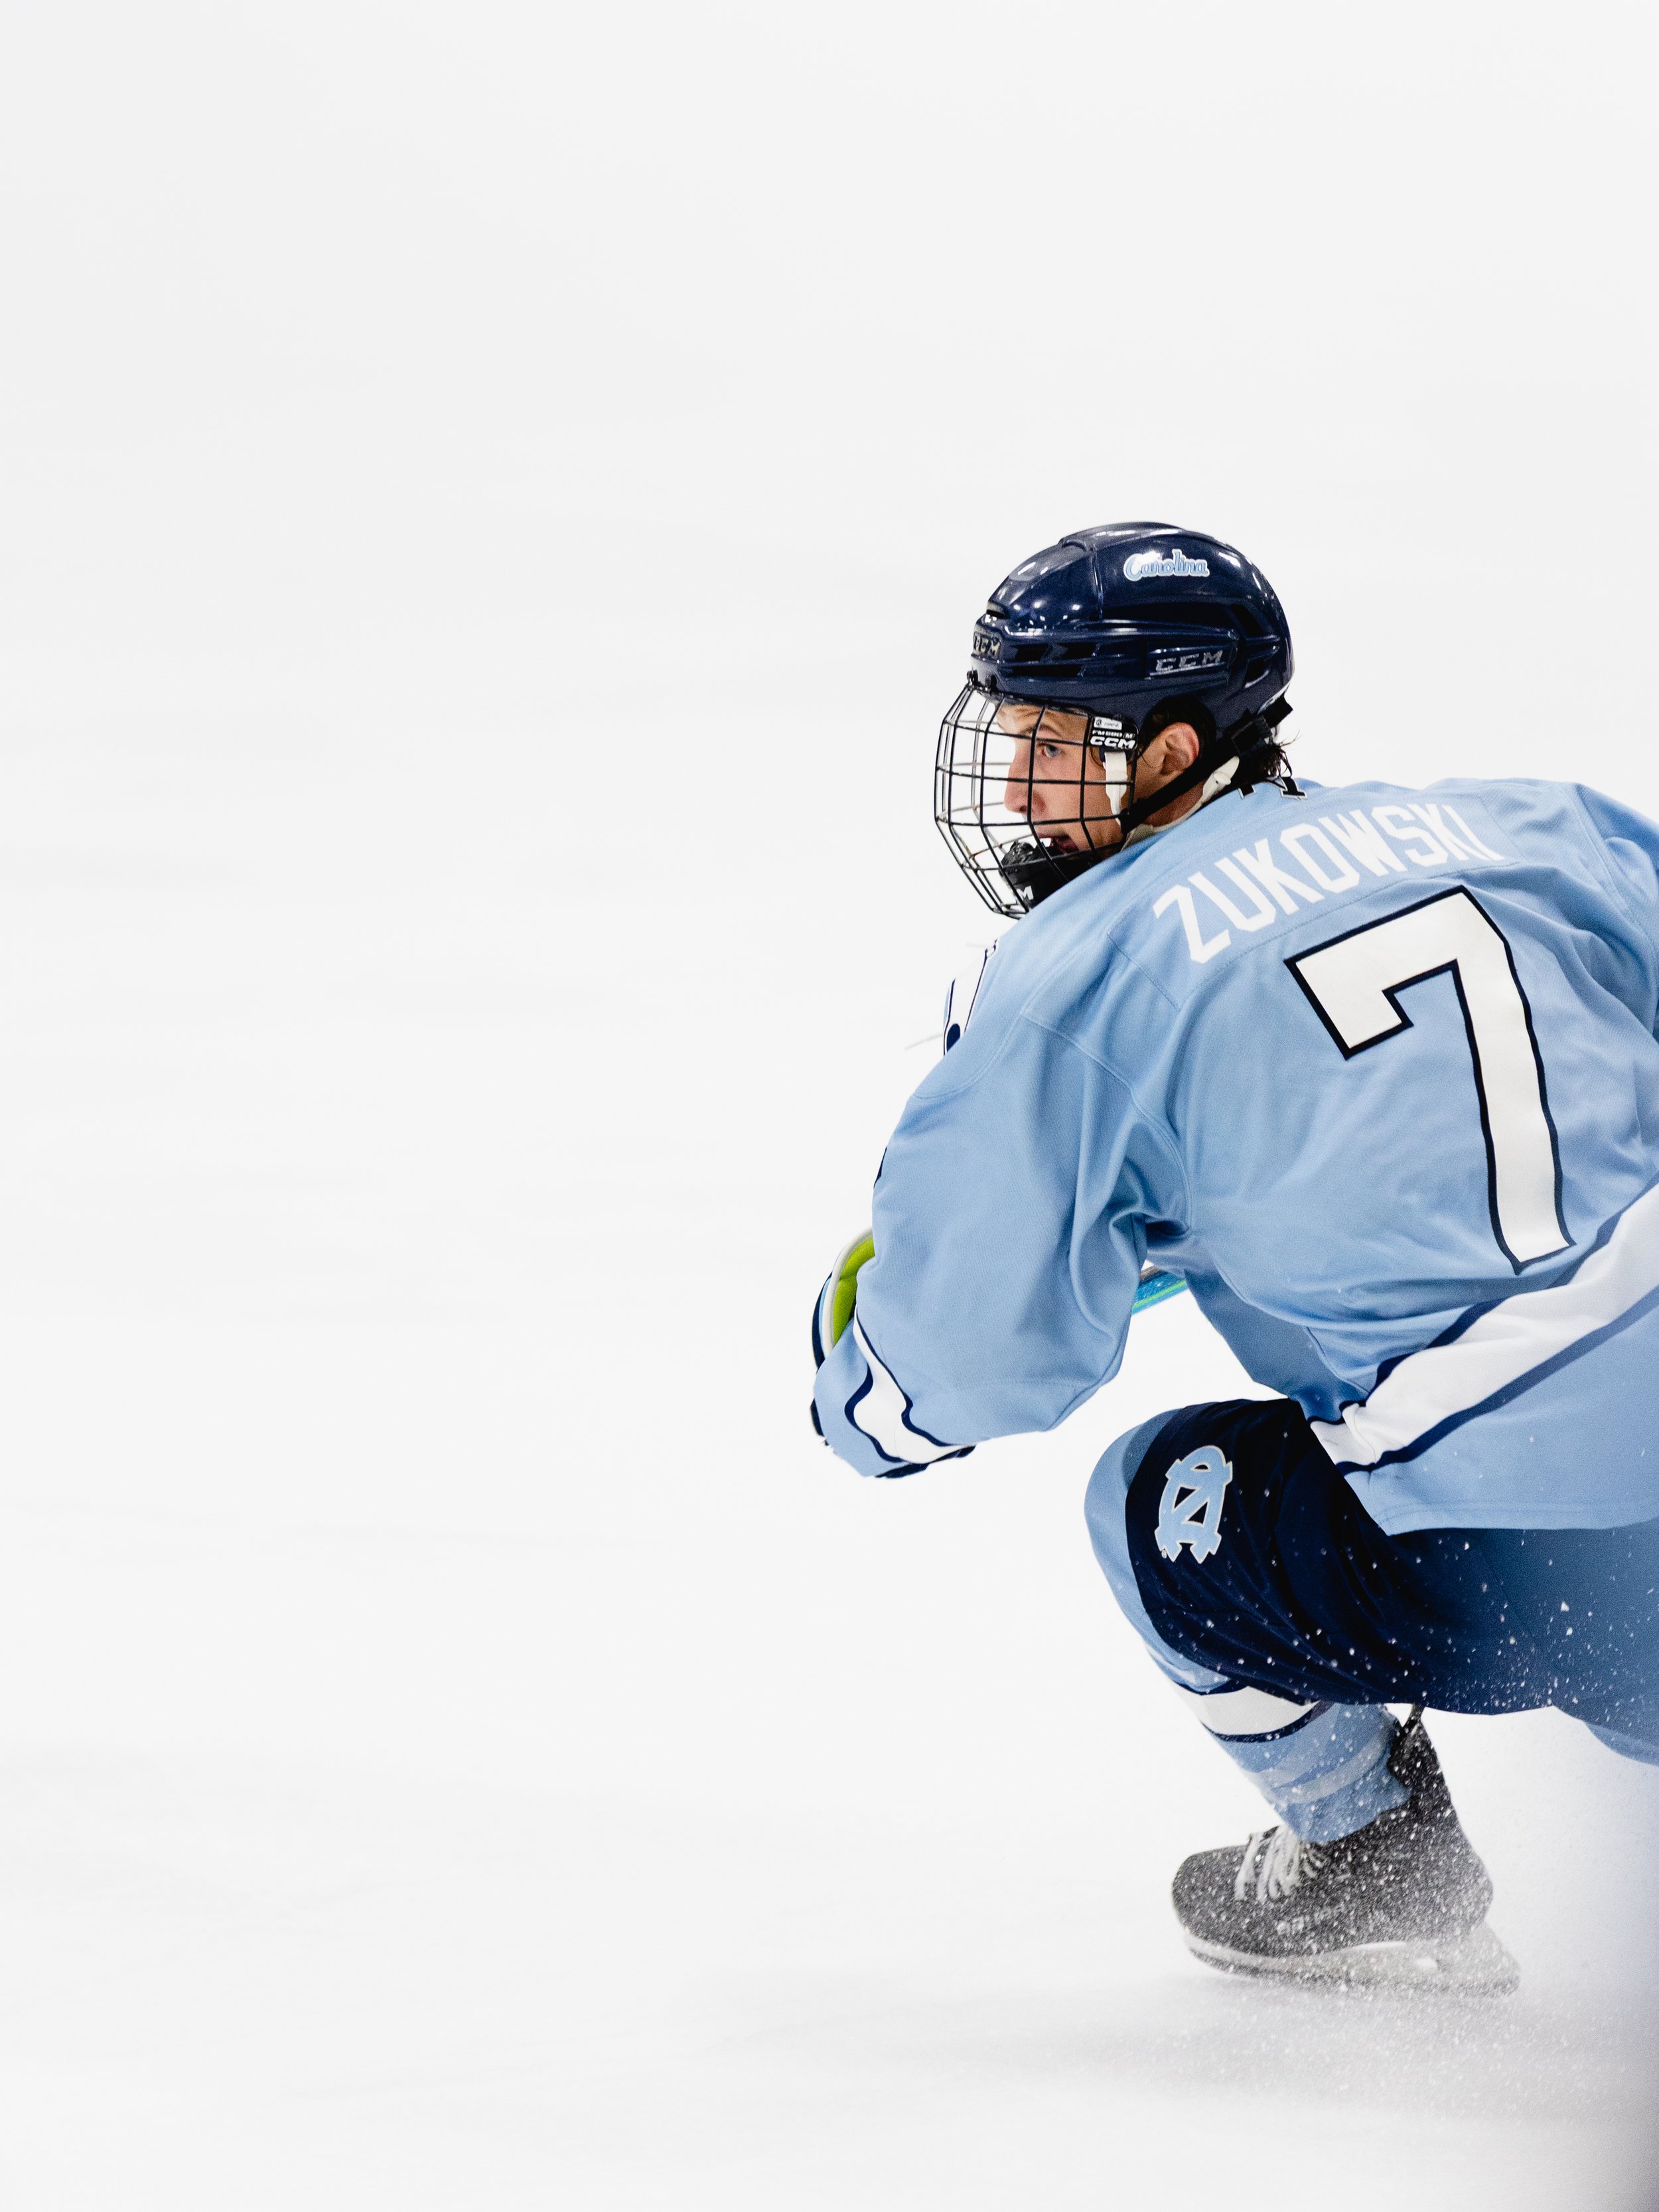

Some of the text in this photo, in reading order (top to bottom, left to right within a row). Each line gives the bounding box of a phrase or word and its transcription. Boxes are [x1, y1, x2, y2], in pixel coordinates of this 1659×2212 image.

[1123, 549, 1210, 581] Carolina
[1156, 650, 1223, 672] CCM
[1090, 736, 1135, 749] CCM
[1153, 803, 1506, 964] ZUKOWSKI
[1284, 885, 1577, 1275] 7
